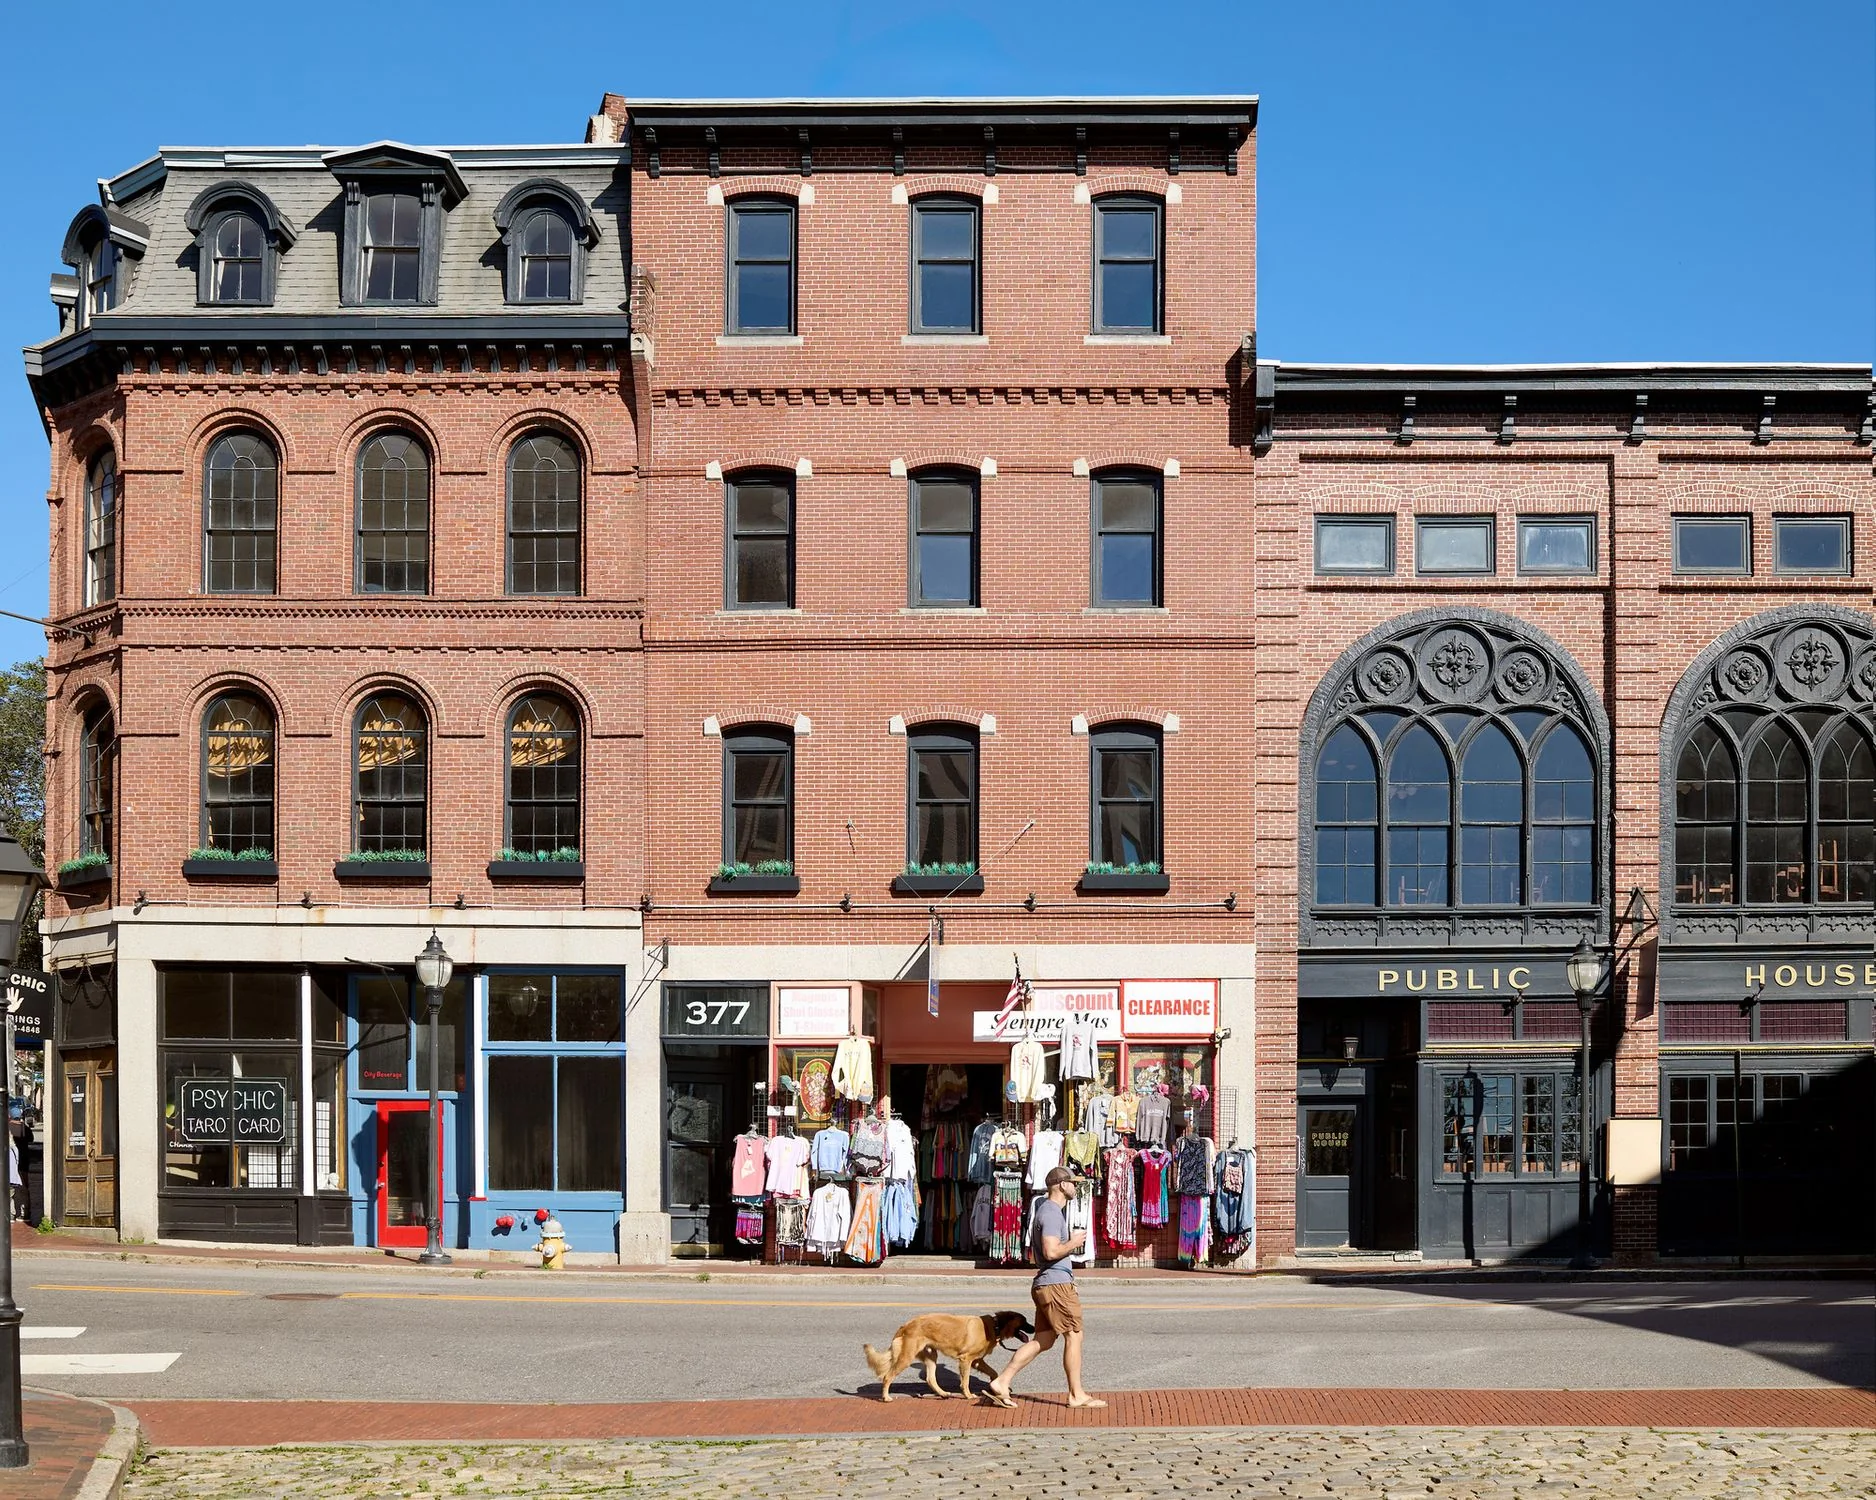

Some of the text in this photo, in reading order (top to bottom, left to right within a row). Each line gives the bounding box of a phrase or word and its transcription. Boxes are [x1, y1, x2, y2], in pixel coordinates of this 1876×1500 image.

[10, 973, 47, 993] CHIC
[1378, 966, 1531, 991] PUBLIC
[1745, 964, 1876, 987] HOUSE
[685, 1001, 751, 1025] 377
[1128, 999, 1210, 1015] CLEARANCE
[14, 1015, 41, 1025] INGS
[192, 1089, 277, 1110] PSYCHIC
[238, 1117, 281, 1134] CARD
[1312, 1132, 1349, 1140] PUBLIC
[1313, 1139, 1347, 1147] HOUSE
